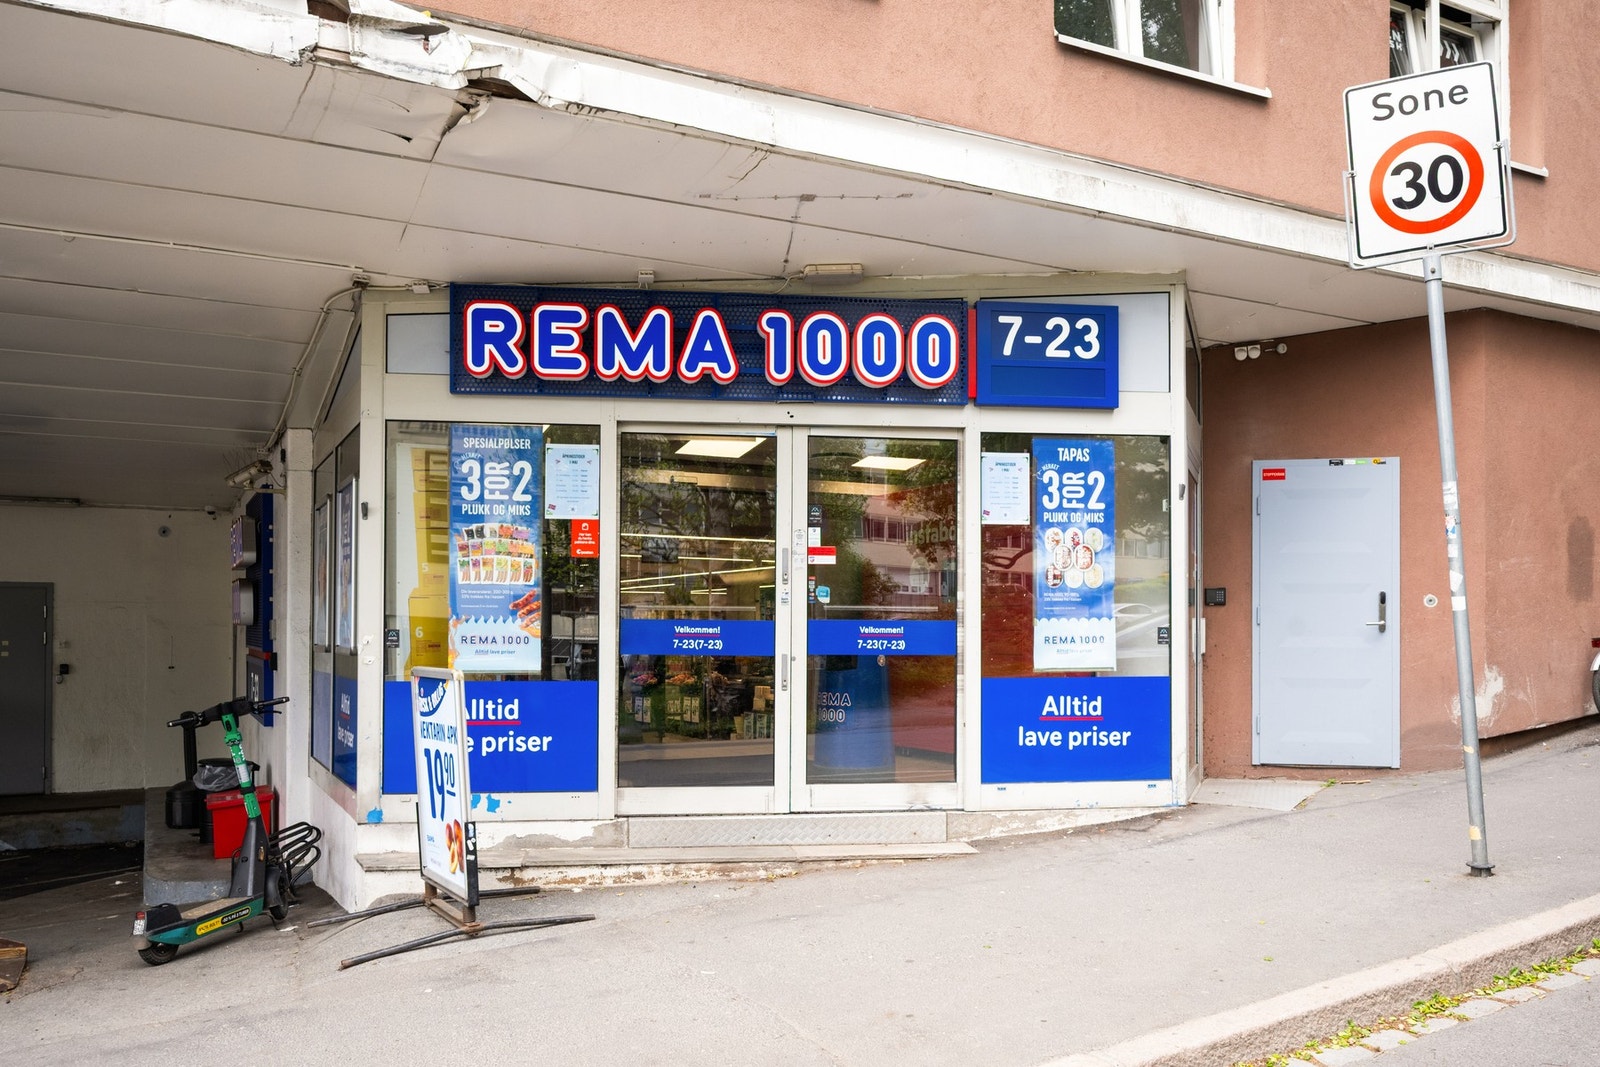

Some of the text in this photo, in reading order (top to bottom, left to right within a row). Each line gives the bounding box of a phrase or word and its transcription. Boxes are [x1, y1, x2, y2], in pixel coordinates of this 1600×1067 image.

[1371, 84, 1469, 121] Sone
[1390, 154, 1464, 210] 30
[463, 299, 960, 390] REMA 1000
[997, 315, 1101, 360] 7-23
[463, 437, 531, 450] SPESIALPØLSER
[1057, 447, 1090, 462] TAPAS
[460, 459, 481, 501] 3
[483, 461, 510, 500] FOR
[512, 460, 533, 502] 2
[1042, 469, 1060, 510] 3
[1062, 471, 1086, 509] FOR
[1087, 470, 1106, 510] 2
[461, 503, 531, 516] PLUKK OG MIKS
[1043, 511, 1105, 523] PLUKK OG MIKS
[415, 626, 424, 638] 6
[674, 625, 721, 634] Velkommen!
[859, 626, 904, 634] Velkommen!
[460, 635, 530, 645] REMA 1000
[673, 639, 723, 650] 7-23(7-23)
[857, 640, 906, 650] 7-23(7-23)
[1044, 635, 1105, 645] REMA 1000
[1042, 695, 1102, 716] Alltid
[481, 730, 553, 757] priser
[1018, 725, 1132, 751] lave priser
